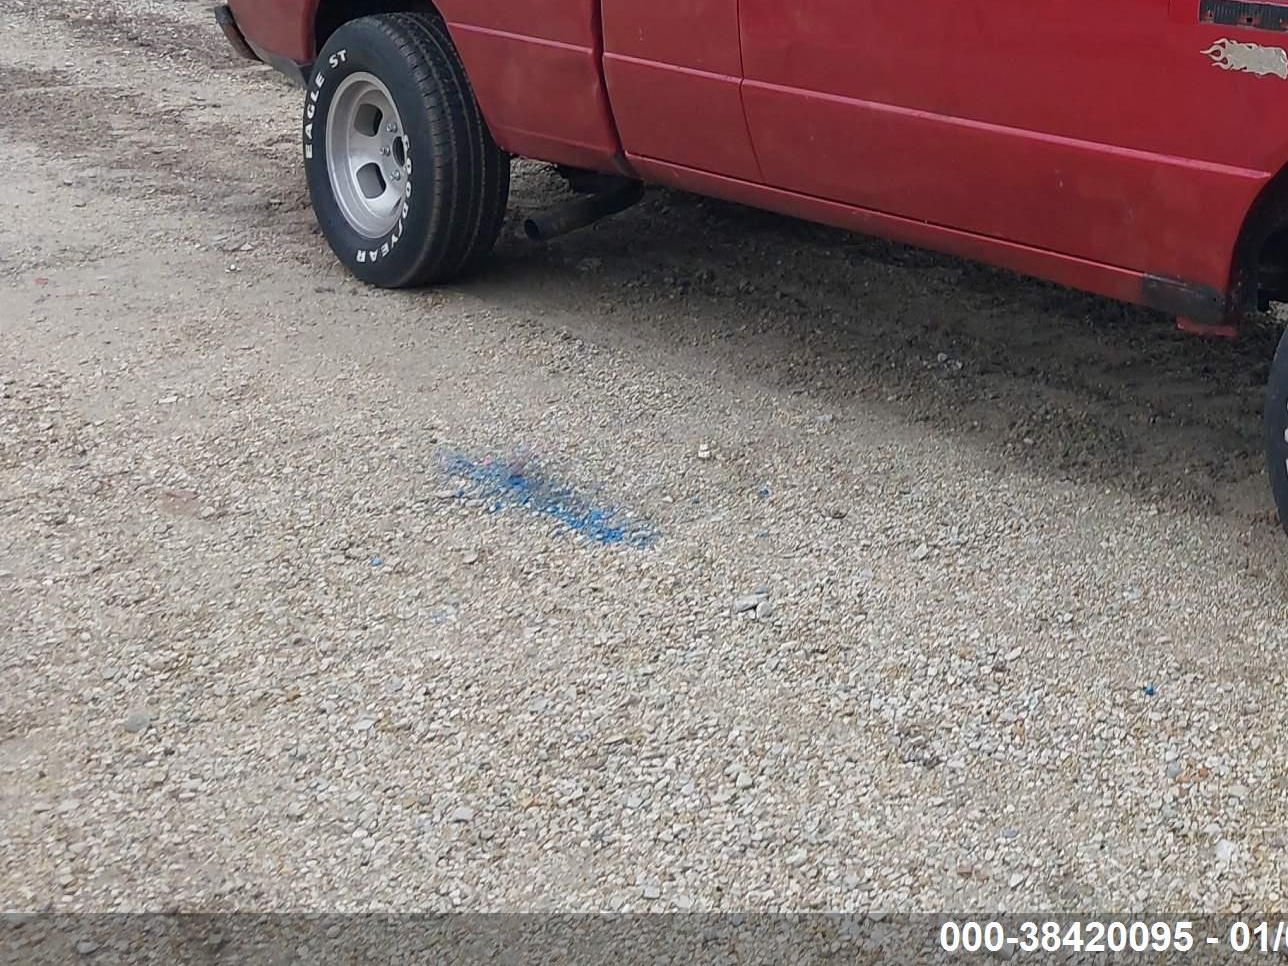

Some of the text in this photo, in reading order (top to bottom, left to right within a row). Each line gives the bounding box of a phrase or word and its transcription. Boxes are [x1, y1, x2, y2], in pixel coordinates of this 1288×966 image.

[304, 48, 349, 160] EAGLE ST
[356, 133, 414, 263] GOODYEAR
